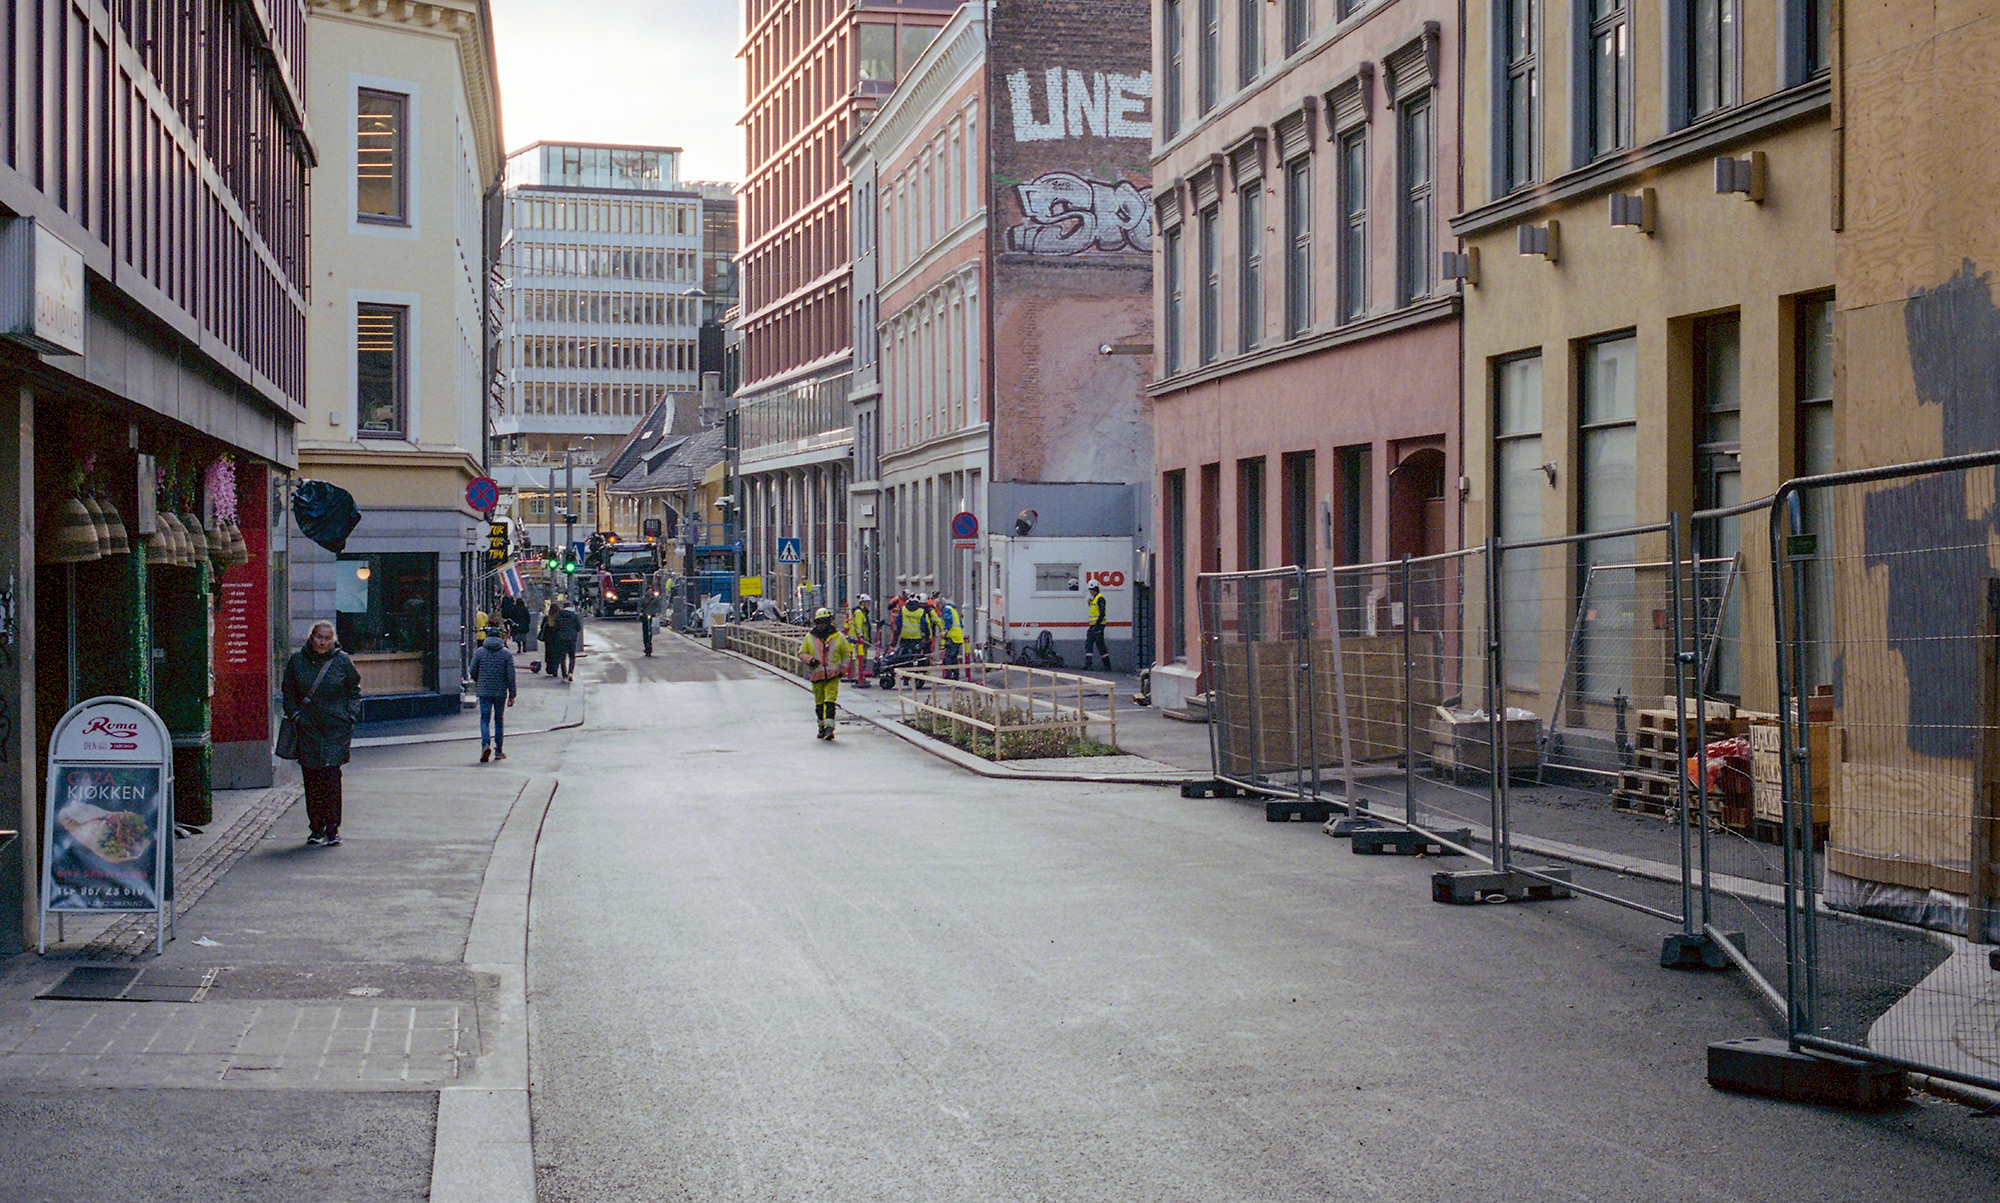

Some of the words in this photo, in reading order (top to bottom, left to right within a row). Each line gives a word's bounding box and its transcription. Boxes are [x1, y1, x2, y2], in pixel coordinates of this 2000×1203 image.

[82, 717, 138, 738] Roma
[67, 771, 115, 785] GAZA
[67, 785, 145, 801] KJØKKEN
